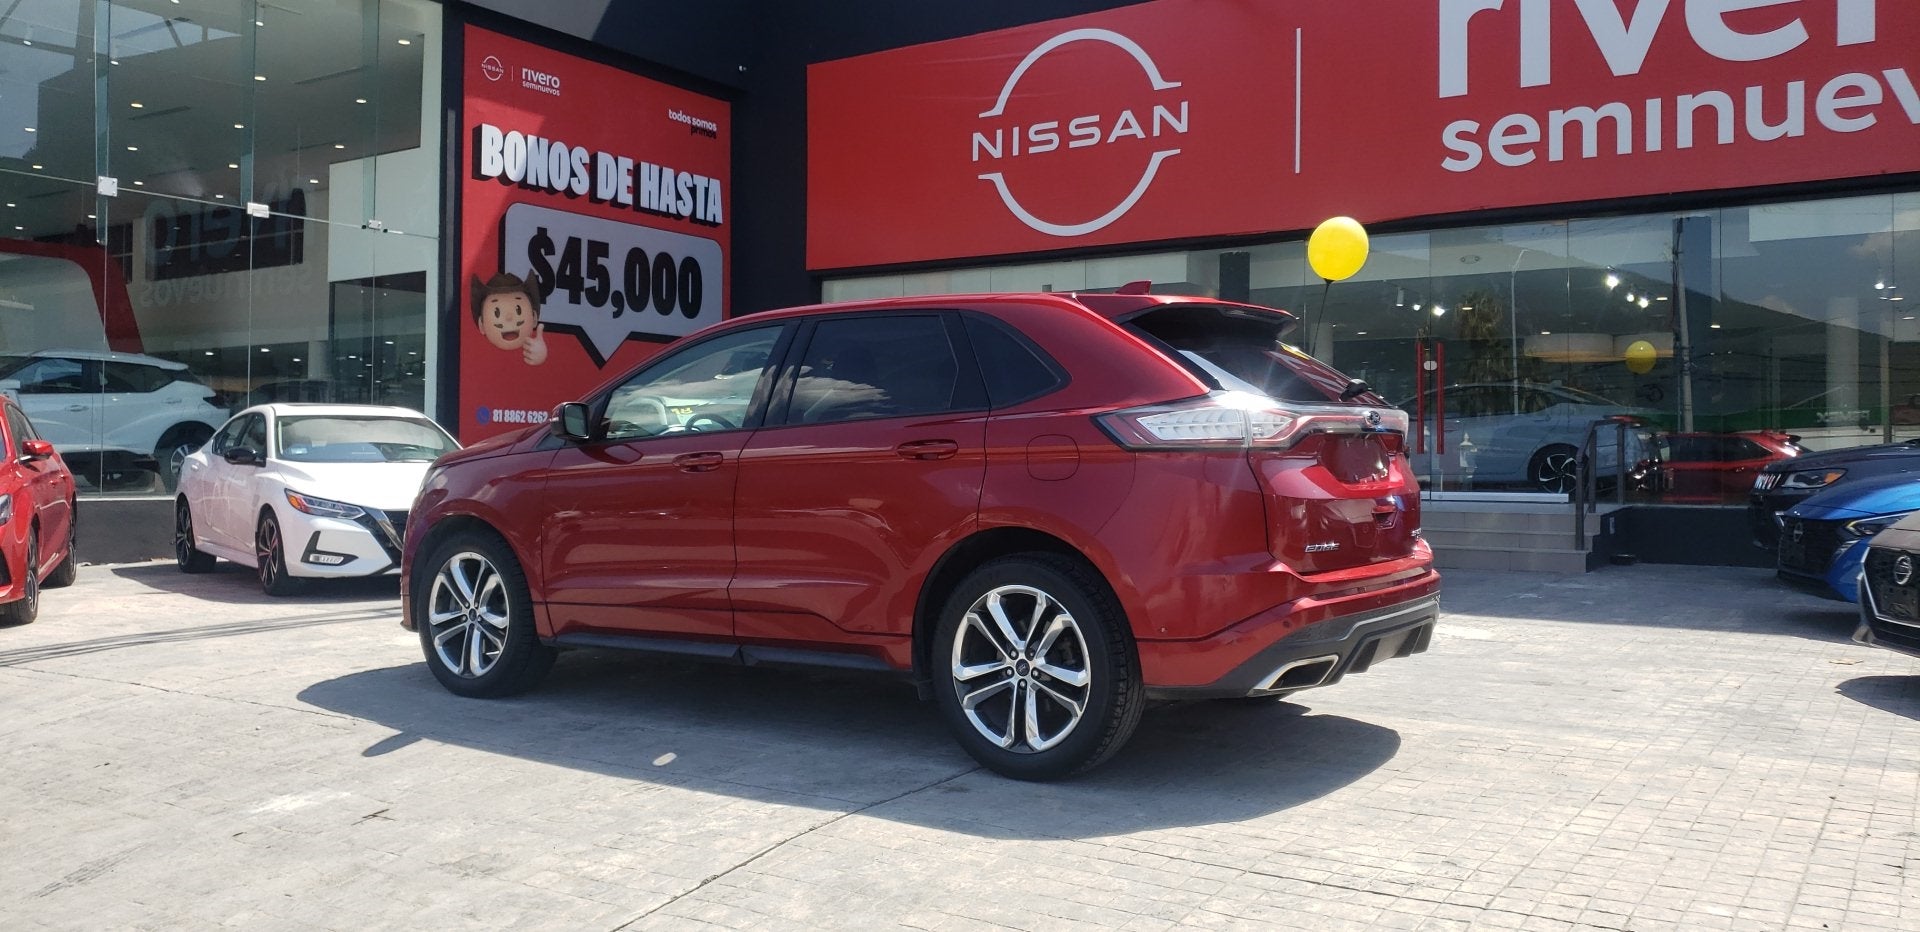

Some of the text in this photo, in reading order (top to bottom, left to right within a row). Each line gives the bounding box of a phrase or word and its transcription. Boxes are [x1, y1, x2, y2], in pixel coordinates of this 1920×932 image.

[481, 63, 504, 74] NISSAN
[522, 67, 560, 88] rivero
[522, 80, 560, 96] seminuevos
[668, 108, 717, 132] todos somos
[972, 101, 1189, 162] NISSAN
[481, 123, 723, 225] BONOS DE HASTA
[527, 226, 703, 319] $45,000
[492, 409, 503, 423] 81
[504, 409, 526, 424] 8862
